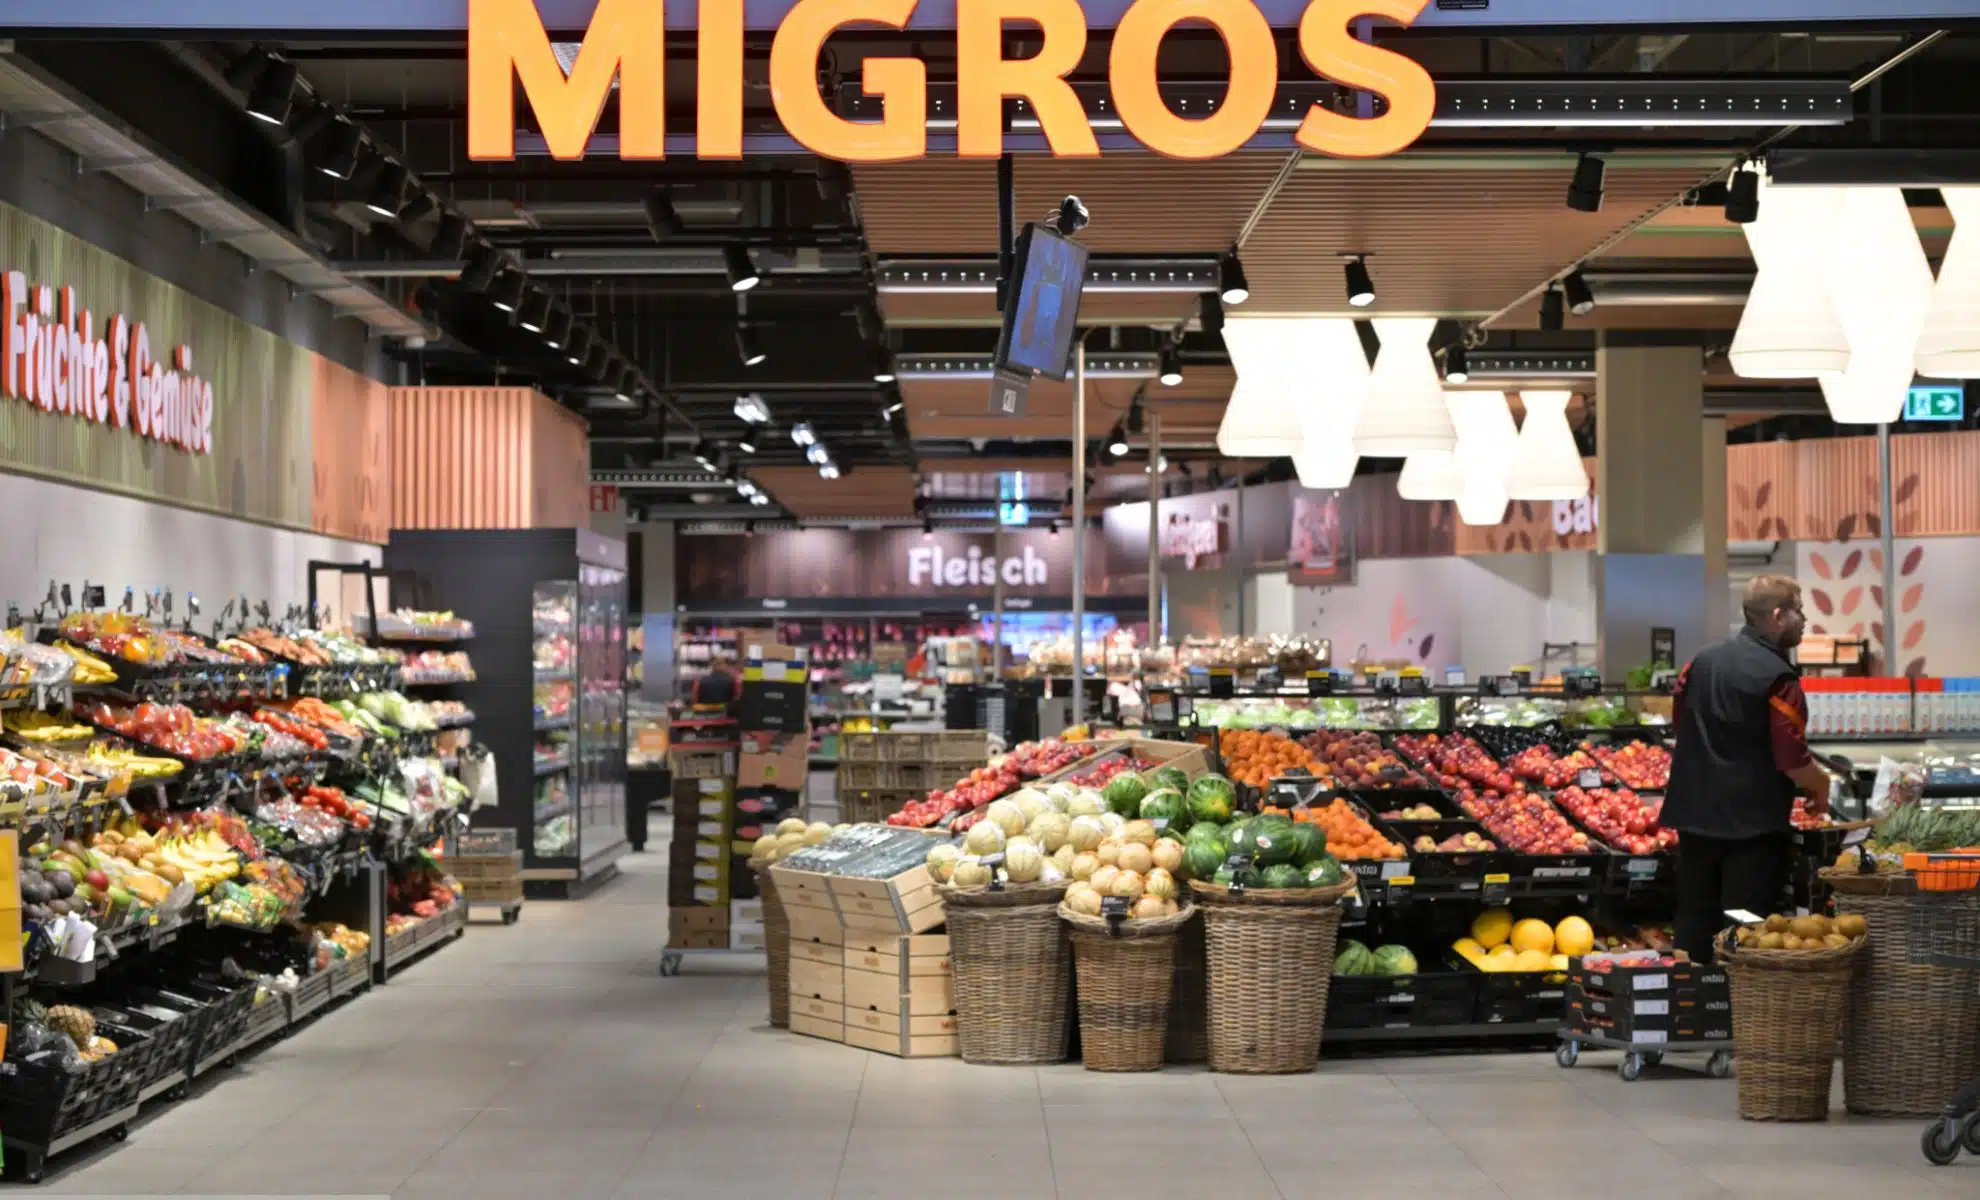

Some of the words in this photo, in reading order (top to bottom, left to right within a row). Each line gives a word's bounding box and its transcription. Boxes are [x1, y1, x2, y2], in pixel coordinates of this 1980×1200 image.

[468, 0, 1436, 159] MIGROS
[2, 270, 109, 424] Früchte
[110, 313, 129, 431] &
[130, 321, 213, 455] Gemüse
[908, 545, 1047, 586] Fleisch
[1552, 495, 1599, 536] Ba
